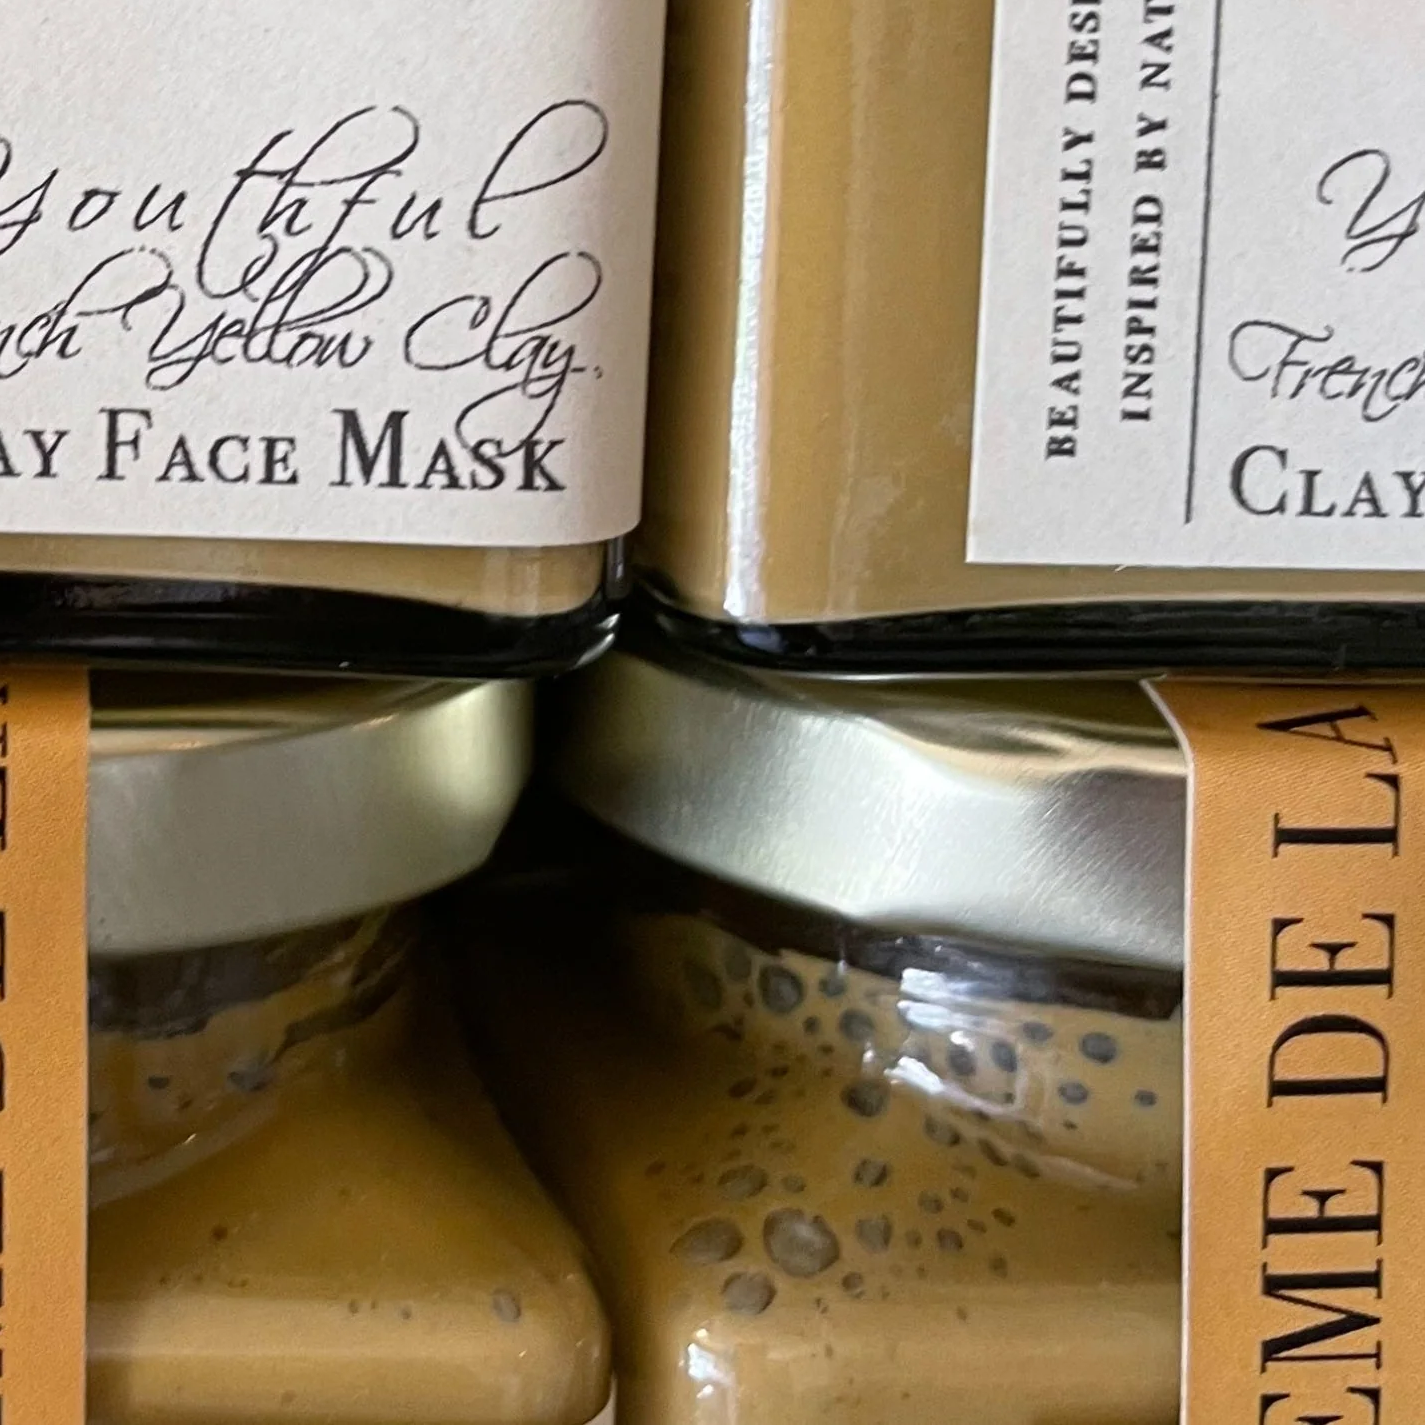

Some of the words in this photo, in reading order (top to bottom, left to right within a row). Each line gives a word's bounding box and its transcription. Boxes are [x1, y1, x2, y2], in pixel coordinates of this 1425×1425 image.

[1133, 112, 1170, 173] BY
[122, 246, 395, 392] Yellow
[1044, 125, 1097, 462] BEAUTIFULLY
[1119, 192, 1166, 425] INSPIRED
[1255, 703, 1401, 859] LA
[1266, 912, 1397, 1109] DE
